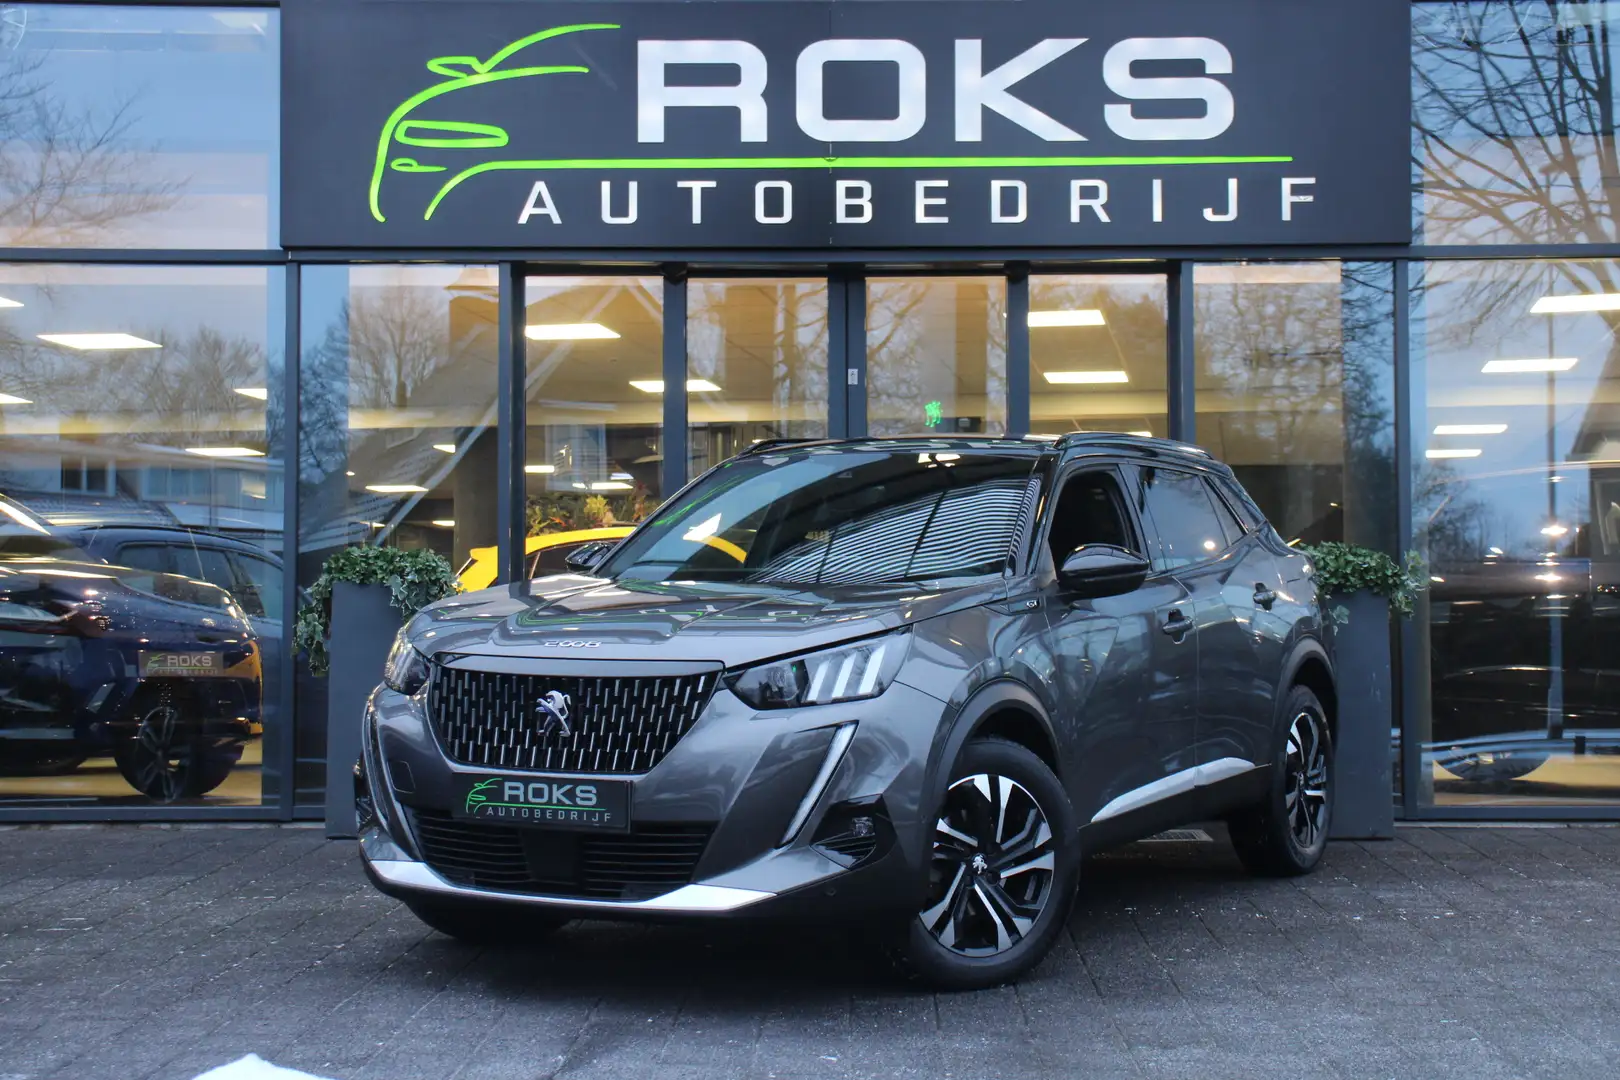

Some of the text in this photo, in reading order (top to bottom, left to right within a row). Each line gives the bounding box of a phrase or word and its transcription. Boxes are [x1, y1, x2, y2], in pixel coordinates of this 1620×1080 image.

[637, 36, 1236, 143] ROKS
[517, 176, 1318, 225] AUTOBEDRIJF
[544, 640, 602, 648] 2008
[167, 655, 213, 667] ROKS
[503, 781, 598, 807] ROKS
[486, 806, 612, 823] AUTOBEDRIJF
